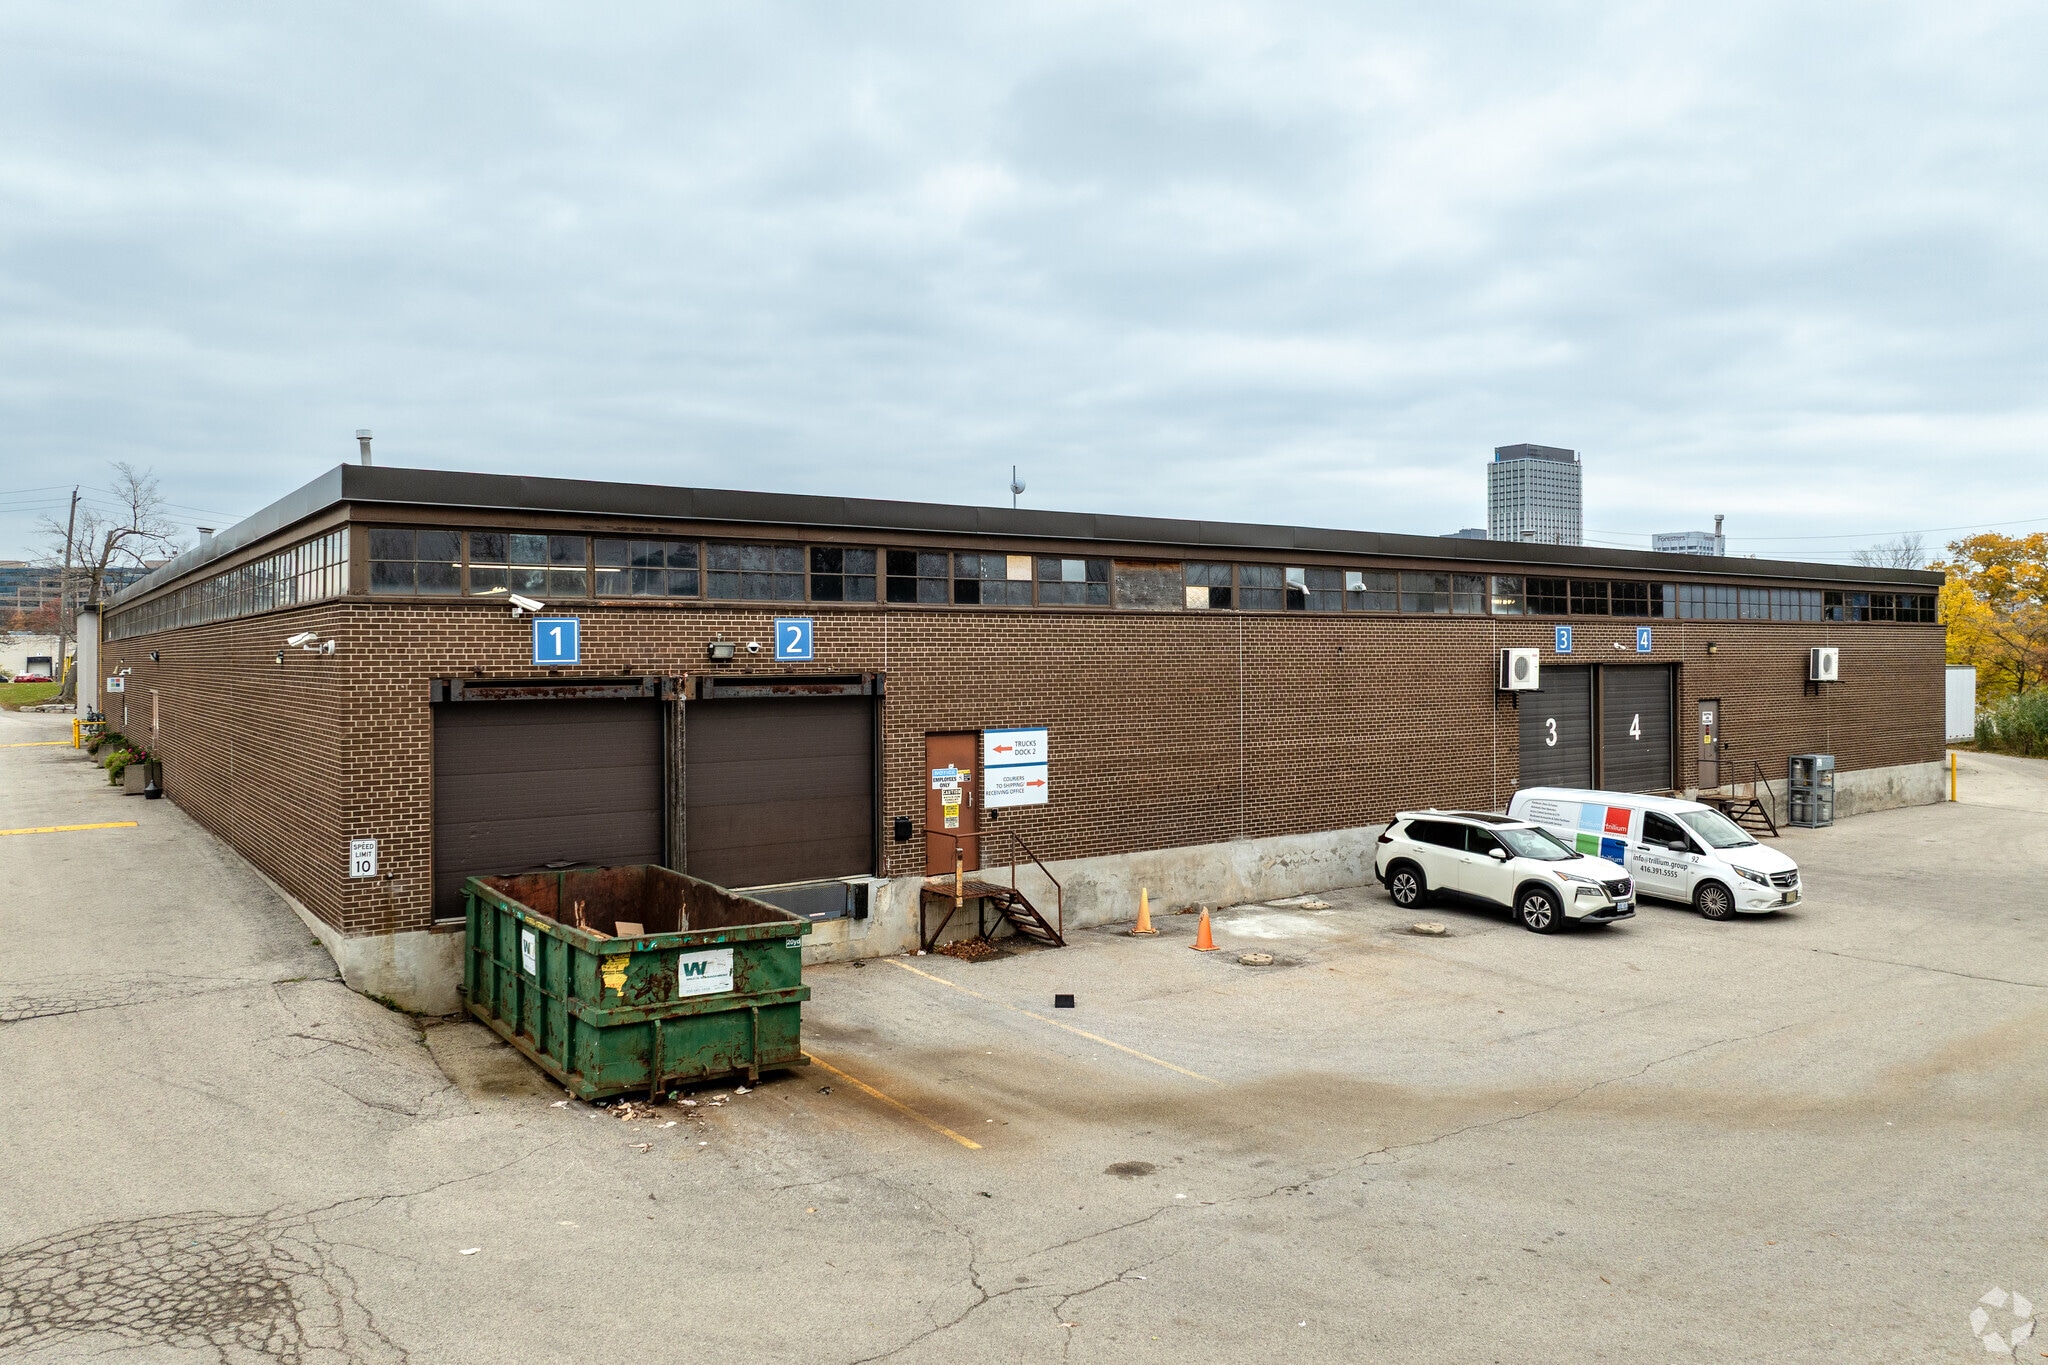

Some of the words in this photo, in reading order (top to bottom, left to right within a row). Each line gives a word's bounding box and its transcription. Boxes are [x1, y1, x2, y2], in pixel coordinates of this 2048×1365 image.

[549, 626, 562, 656] 1
[786, 626, 803, 653] 2
[1559, 630, 1568, 649] 3
[1640, 631, 1649, 648] 4
[1545, 718, 1557, 746] 3
[1629, 713, 1641, 741] 4
[1605, 823, 1627, 832] trillium
[356, 860, 371, 873] 10
[1691, 855, 1699, 863] 92
[1640, 865, 1678, 878] 416.391.5555
